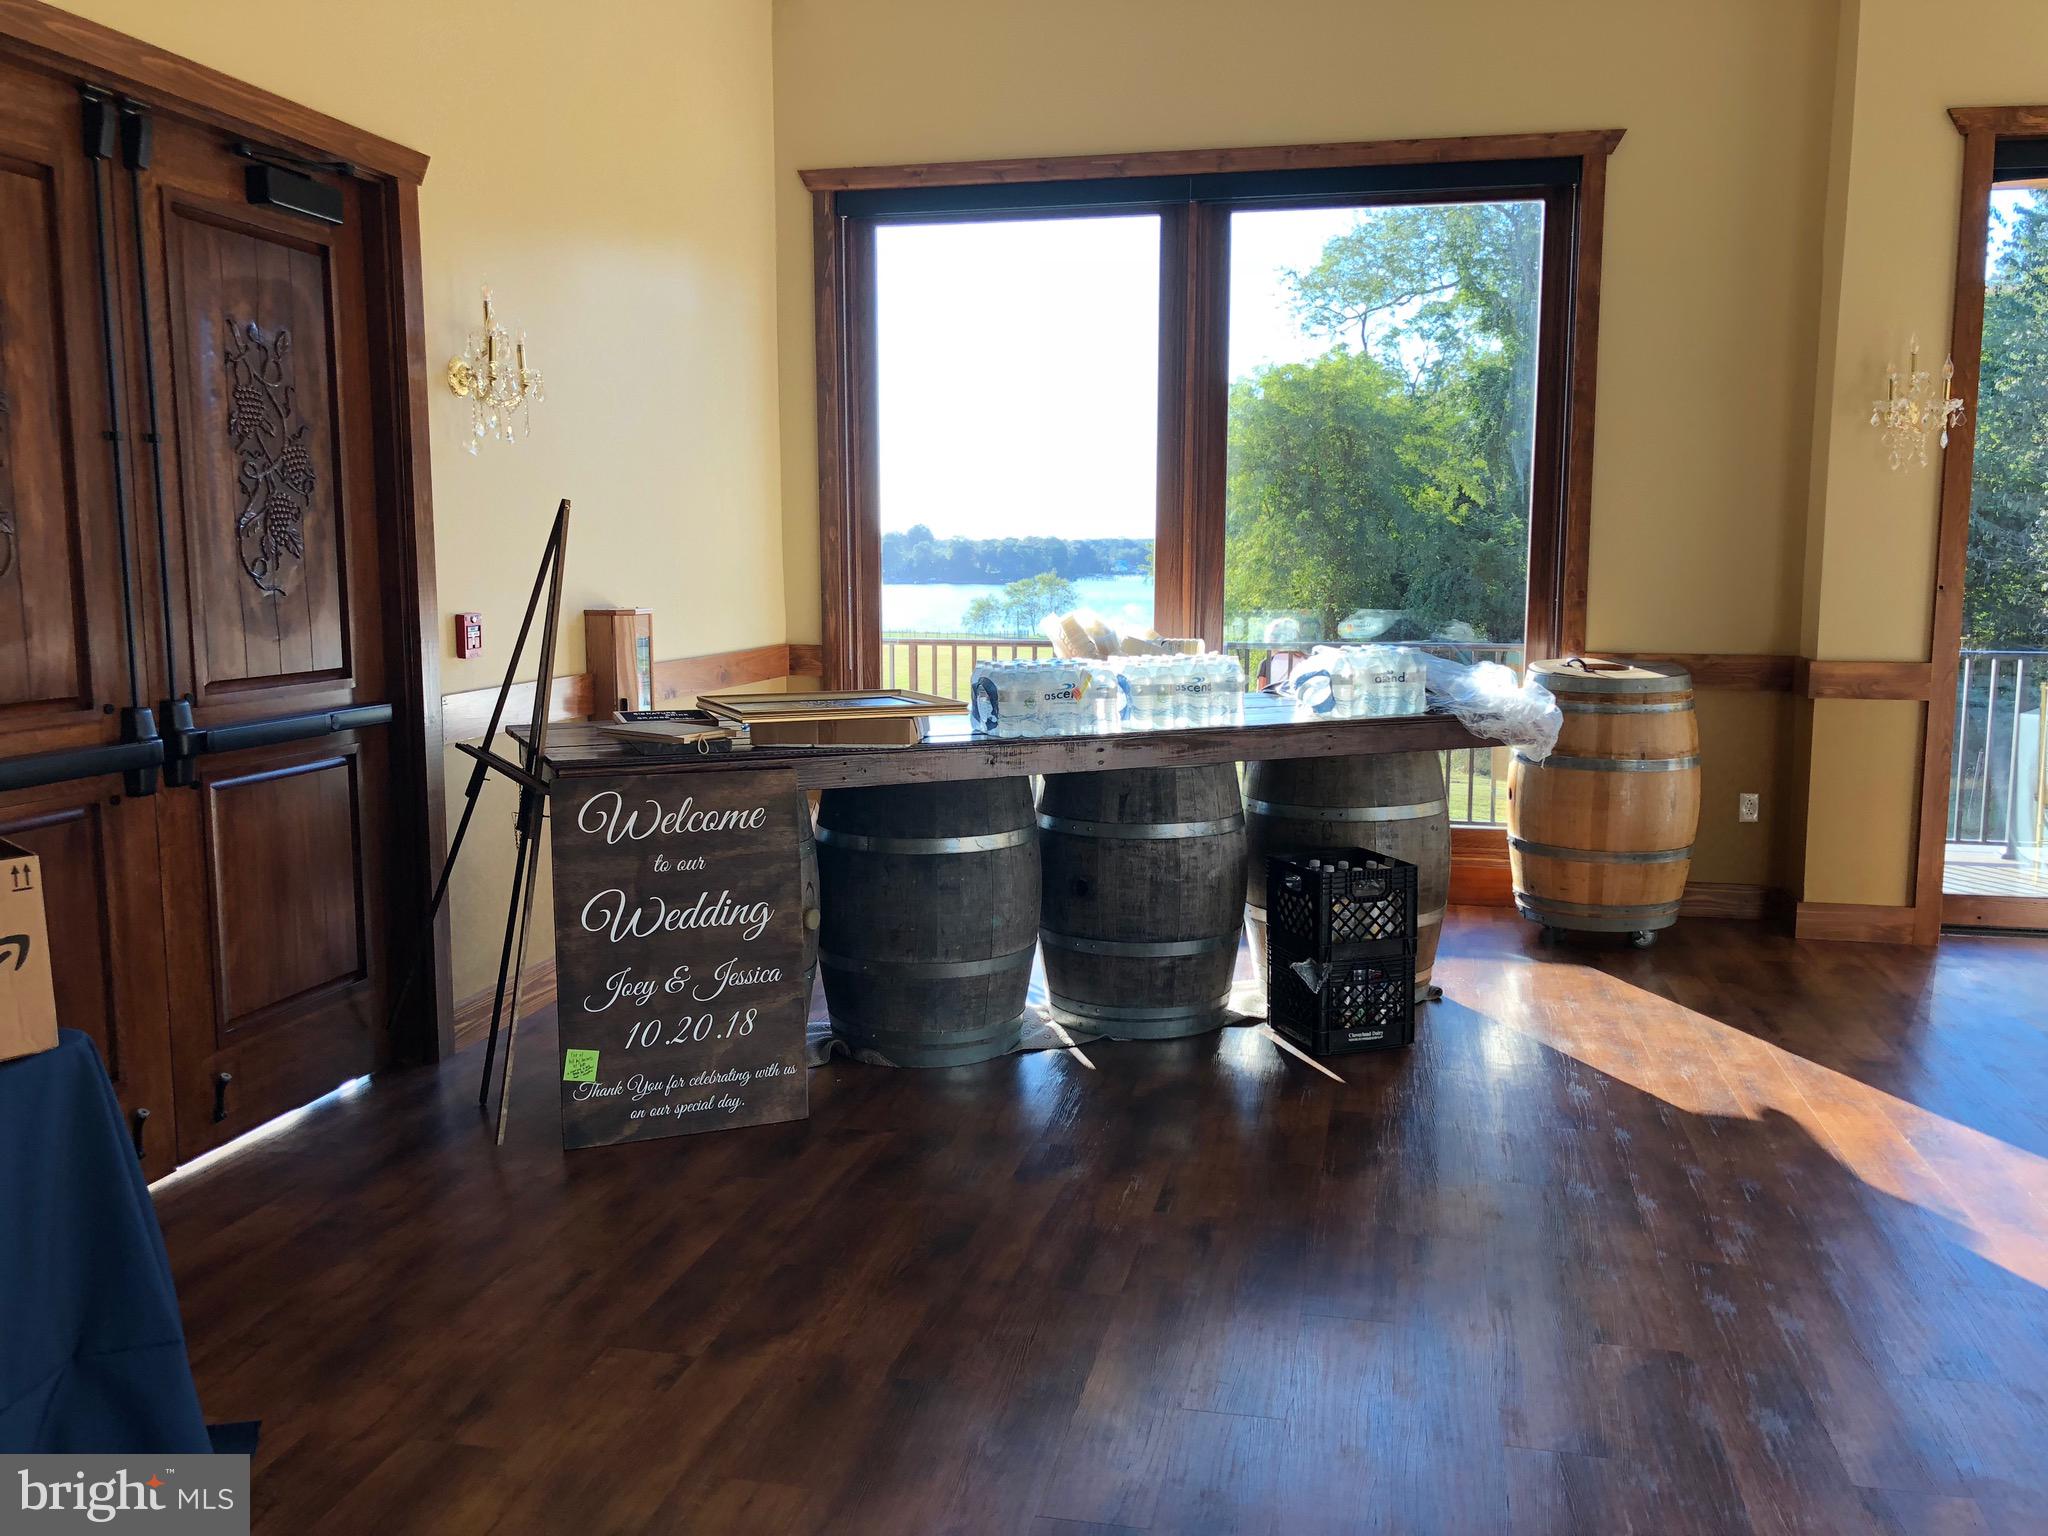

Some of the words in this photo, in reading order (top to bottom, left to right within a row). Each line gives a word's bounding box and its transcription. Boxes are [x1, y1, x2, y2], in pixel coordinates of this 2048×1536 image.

[1044, 690, 1077, 701] asce
[578, 791, 766, 844] Welcome
[654, 854, 671, 872] to
[677, 856, 706, 871] our
[581, 889, 775, 943] Wedding
[584, 967, 658, 1012] Joey
[664, 965, 691, 993] &
[692, 957, 783, 1002] Jessica
[624, 1008, 758, 1050] 10.20.18
[573, 1081, 624, 1101] Thank
[627, 1073, 663, 1101] You
[666, 1075, 685, 1096] for
[689, 1069, 751, 1087] celebrating
[755, 1062, 780, 1079] with
[783, 1063, 798, 1075] us
[630, 1106, 646, 1119] on
[650, 1103, 672, 1117] our
[674, 1095, 715, 1118] special
[717, 1093, 745, 1113] day.
